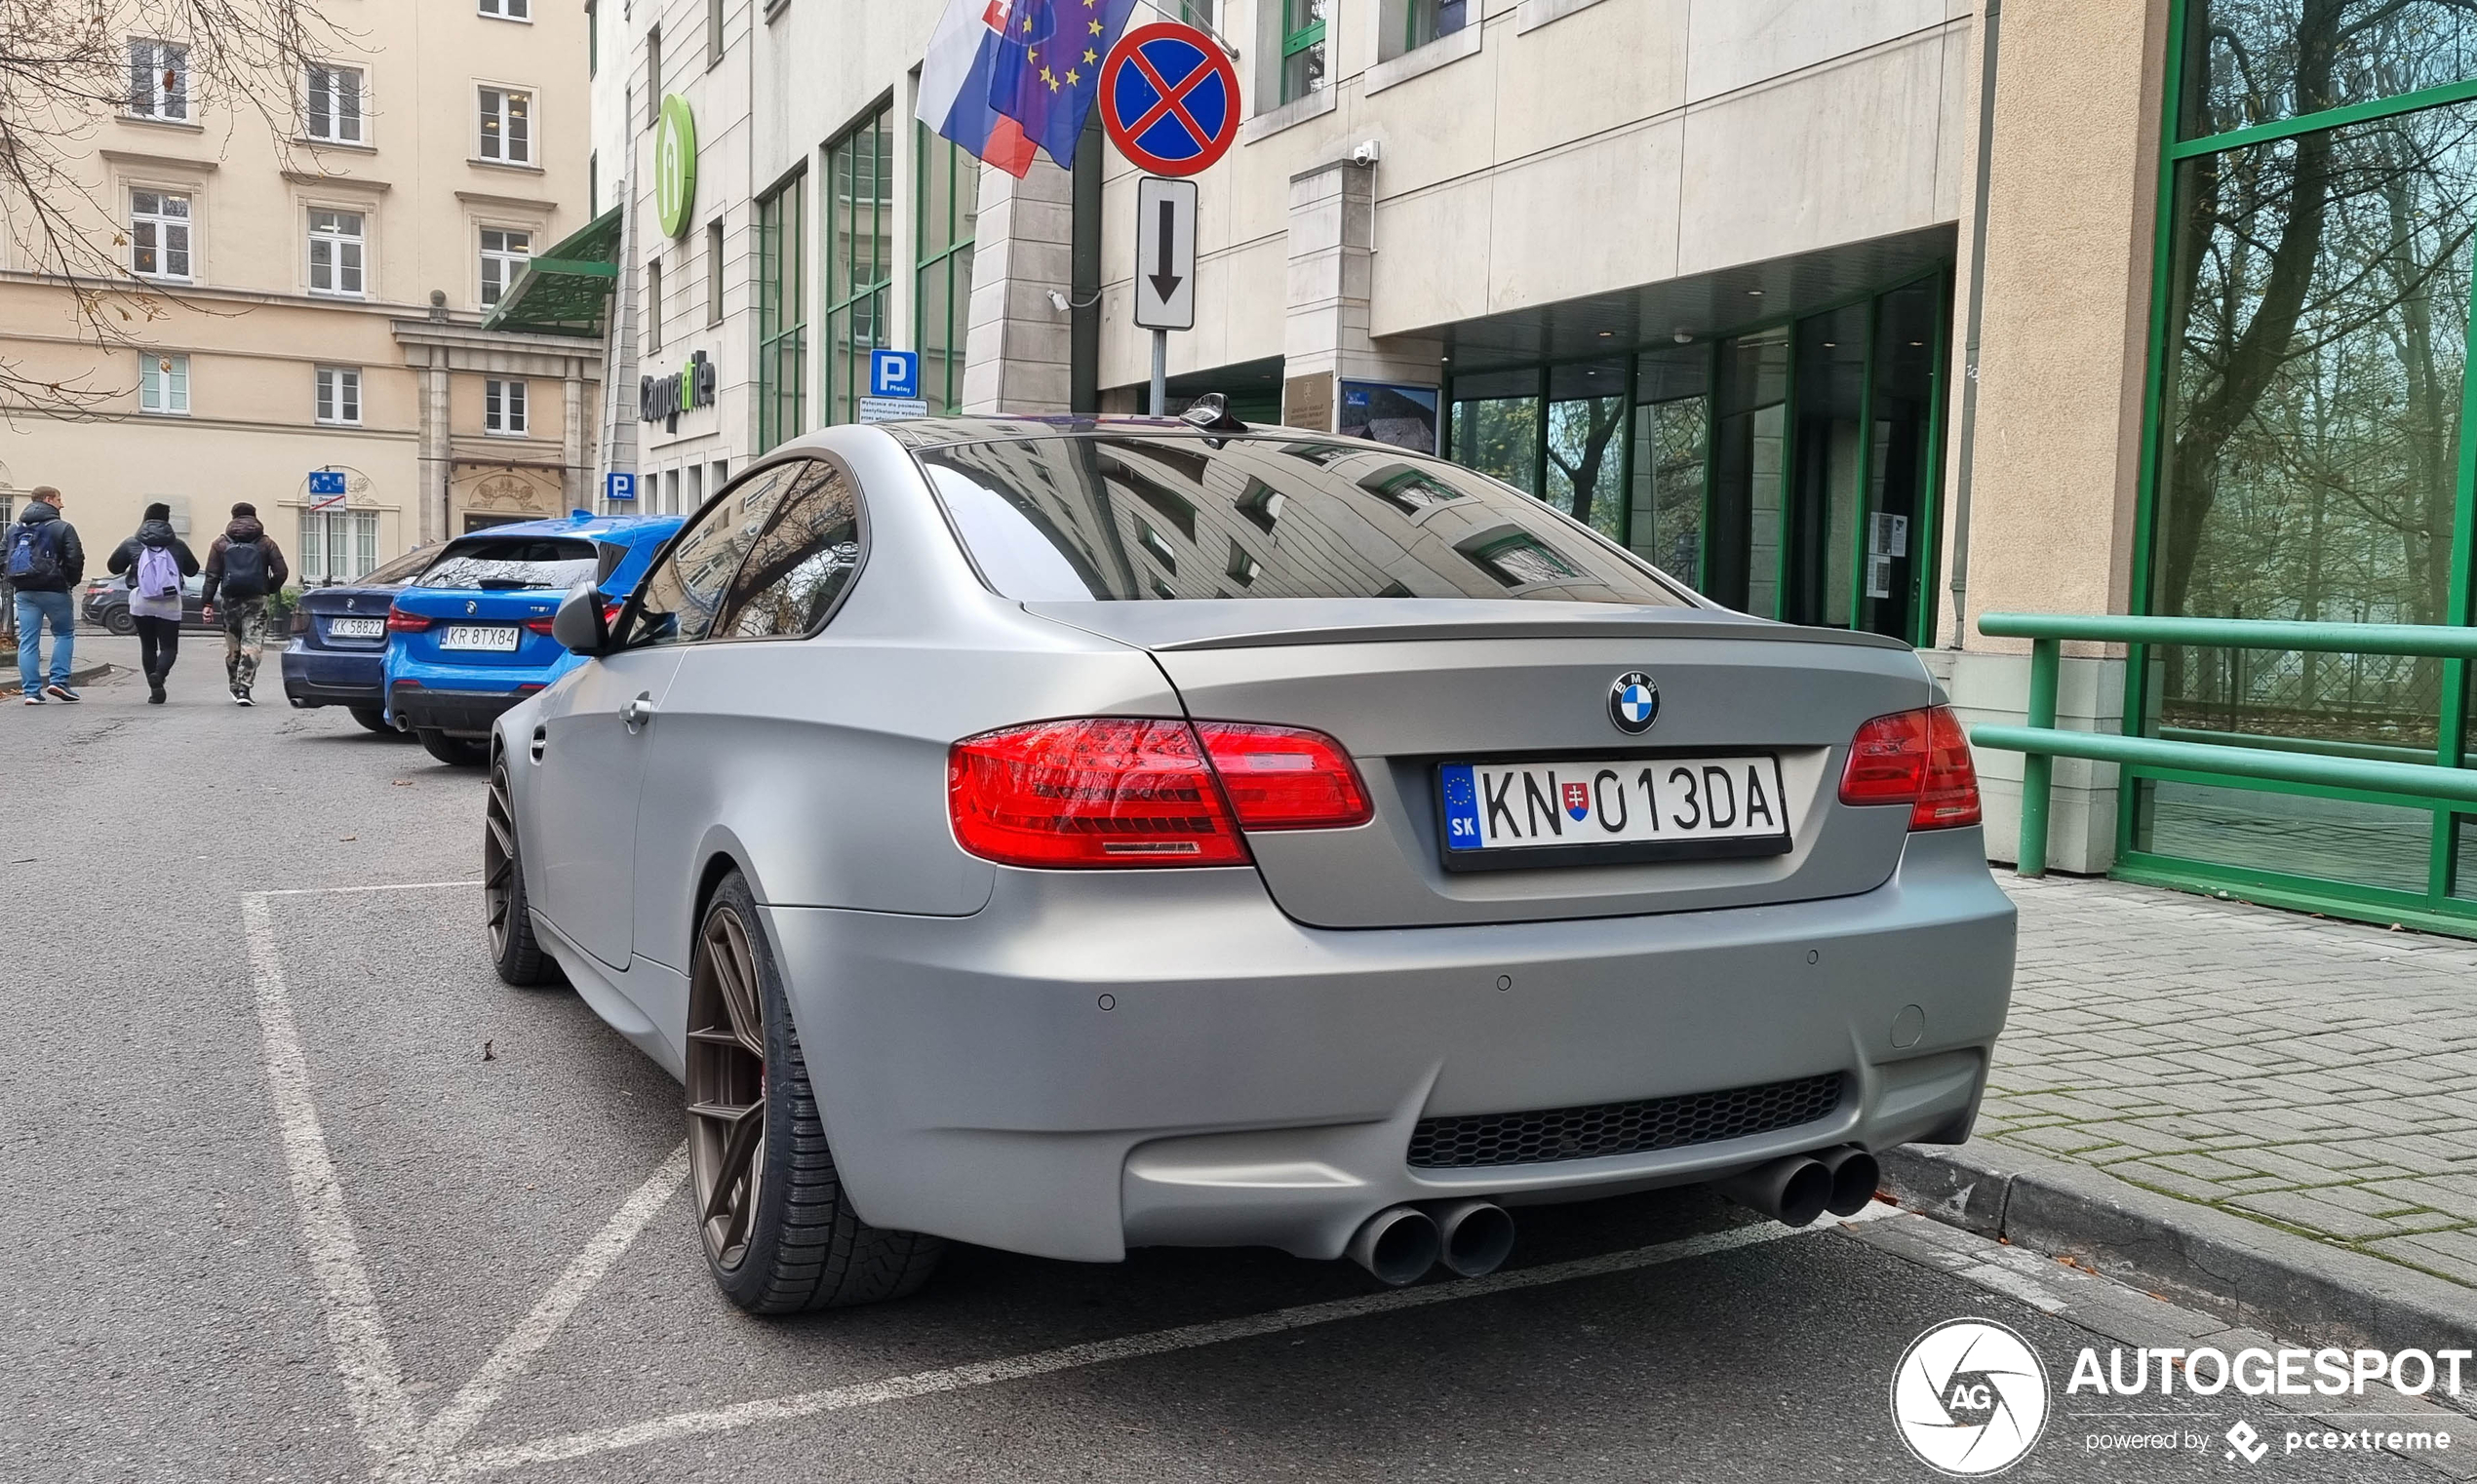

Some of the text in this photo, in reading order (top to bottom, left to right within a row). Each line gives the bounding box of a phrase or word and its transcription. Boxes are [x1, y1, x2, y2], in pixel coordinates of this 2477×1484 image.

[881, 355, 906, 391] P
[640, 350, 716, 434] Campanile
[613, 476, 628, 496] P
[334, 619, 347, 633] KK
[350, 620, 381, 635] 58822
[450, 628, 515, 645] KR 8TX84
[1614, 673, 1657, 695] BMW
[1451, 764, 1775, 839] SK KN 013DA
